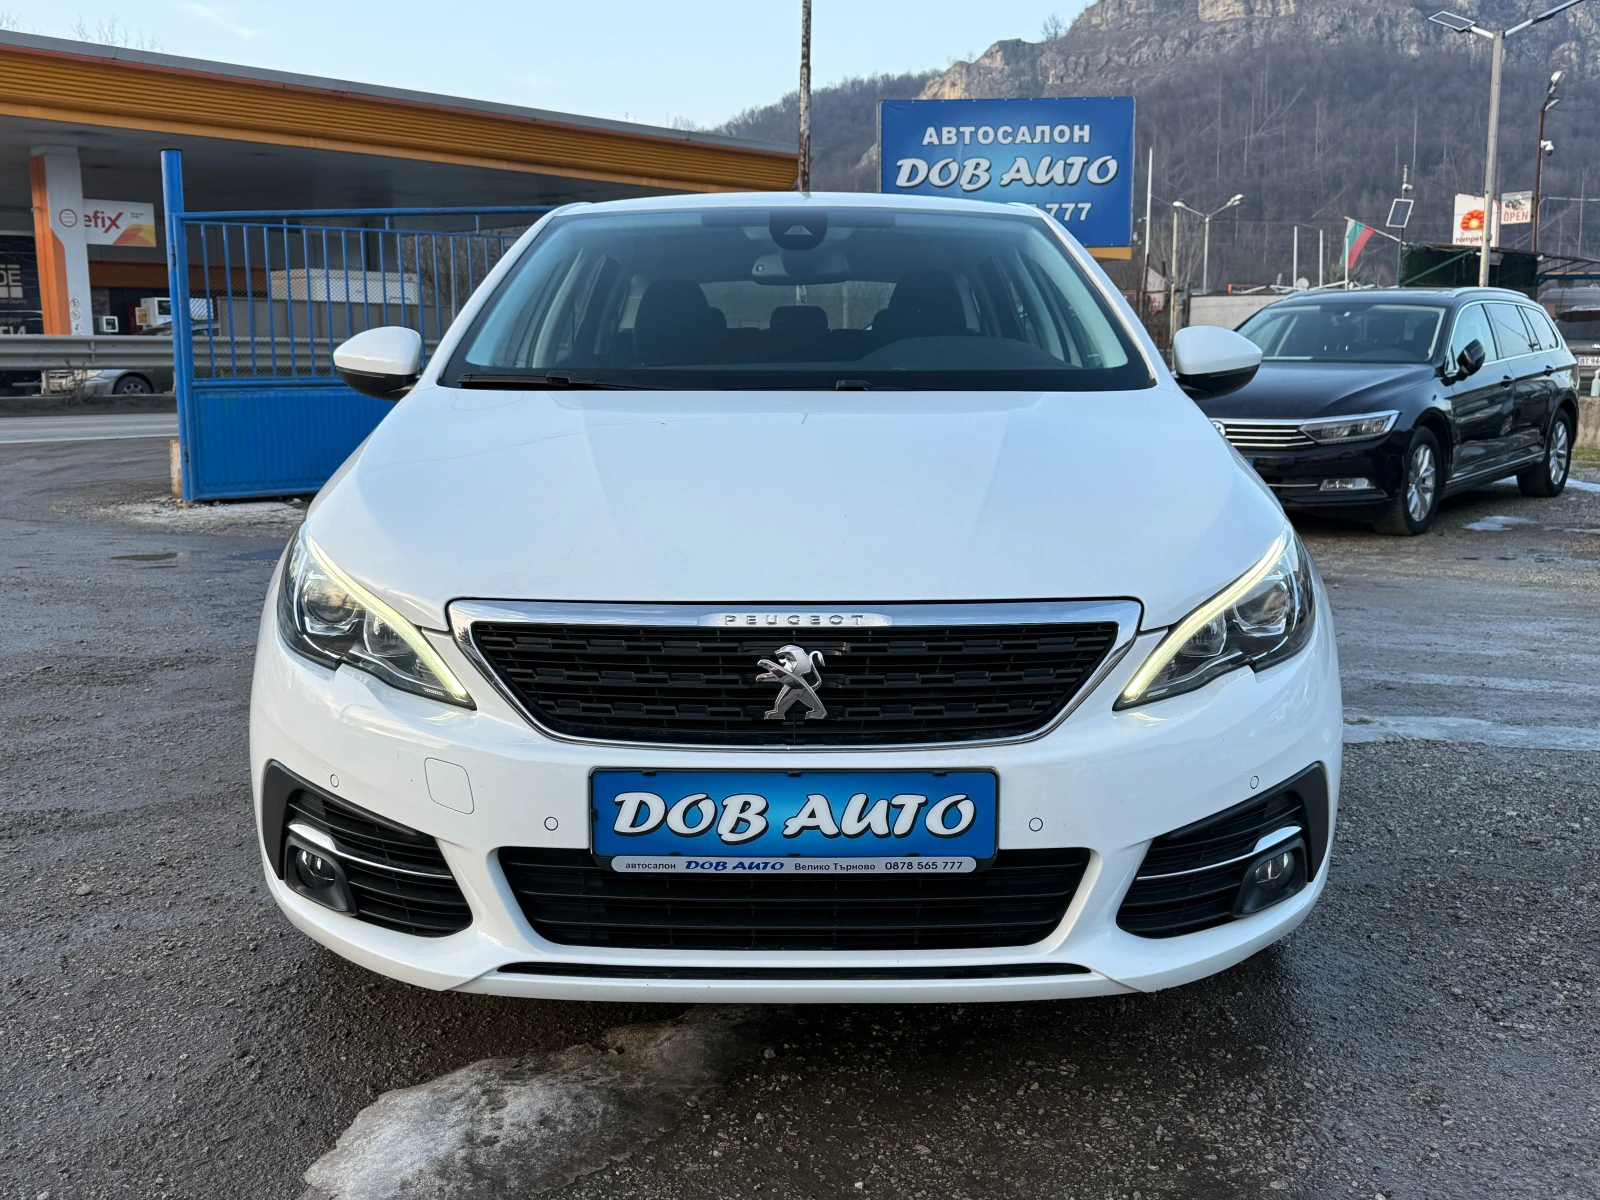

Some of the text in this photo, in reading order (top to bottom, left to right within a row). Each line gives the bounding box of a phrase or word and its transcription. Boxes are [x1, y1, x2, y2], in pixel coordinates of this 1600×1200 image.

[922, 125, 1091, 145] АВТОСАЛОН
[895, 155, 1119, 191] DOB AUTO
[1046, 203, 1092, 221] 777
[1503, 211, 1529, 222] OPEN
[724, 615, 864, 625] PEUGEOT
[613, 792, 976, 845] DOB AUTO
[625, 860, 963, 873] автосалон DOB AUTO Велико Търново 0878 565 777
